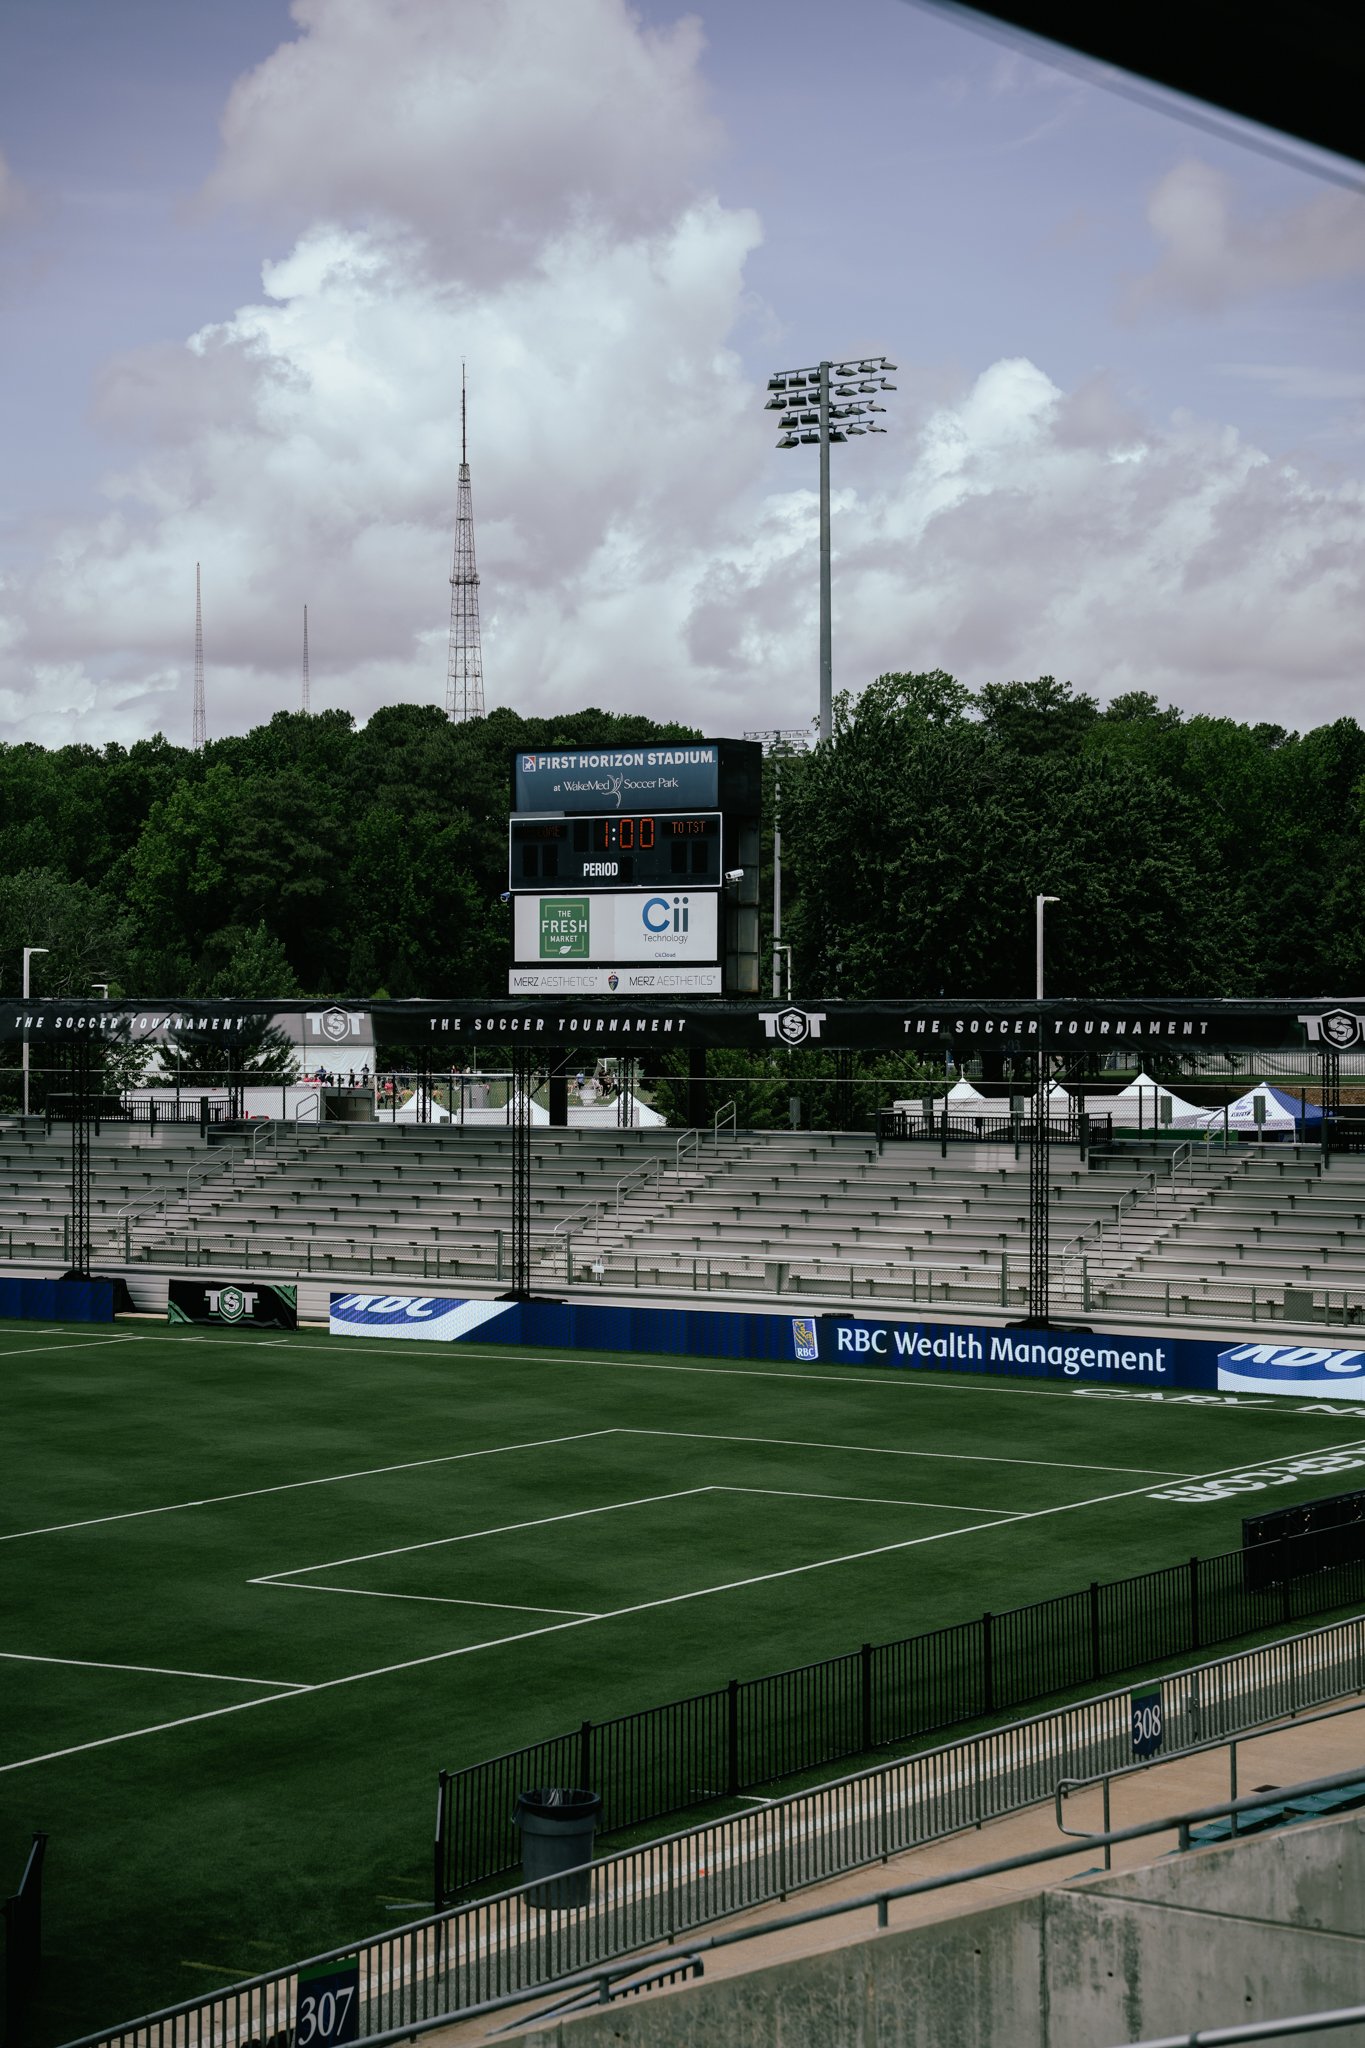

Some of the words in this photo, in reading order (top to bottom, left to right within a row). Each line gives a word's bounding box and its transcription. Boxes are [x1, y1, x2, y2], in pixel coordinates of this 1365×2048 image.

[538, 756, 577, 770] FIRST
[579, 753, 644, 768] HORIZON
[647, 750, 713, 766] STADIUM
[563, 780, 610, 792] WakeMed
[623, 778, 657, 790] Soccer
[658, 777, 679, 788] Park
[605, 818, 655, 848] 1:00
[671, 821, 683, 834] TO
[687, 820, 706, 833] TST
[583, 862, 619, 877] PERIOD
[557, 910, 572, 918] THE
[642, 896, 689, 933] Cii
[541, 919, 588, 933] FRESH
[550, 935, 578, 943] MARKET
[643, 933, 688, 945] Technology
[513, 976, 539, 987] MERZ
[629, 975, 655, 986] MERZ
[14, 1016, 45, 1028] THE
[55, 1016, 118, 1029] SOCCER
[130, 1017, 244, 1030] TOURNAMENT
[429, 1018, 462, 1031] THE
[474, 1018, 546, 1031] SOCCER
[558, 1018, 687, 1032] TOURNAMENT
[903, 1020, 942, 1033] THE
[955, 1019, 1039, 1034] SOCCER
[1054, 1020, 1209, 1035] TOURNAMENT
[204, 1288, 259, 1314] TST
[796, 1347, 815, 1358] RBC
[837, 1327, 888, 1353] RBC
[893, 1331, 983, 1360] Wealth
[989, 1336, 1166, 1375] Management
[1072, 1388, 1277, 1406] CARY
[1133, 1704, 1161, 1745] 308
[298, 1985, 355, 2046] 307
